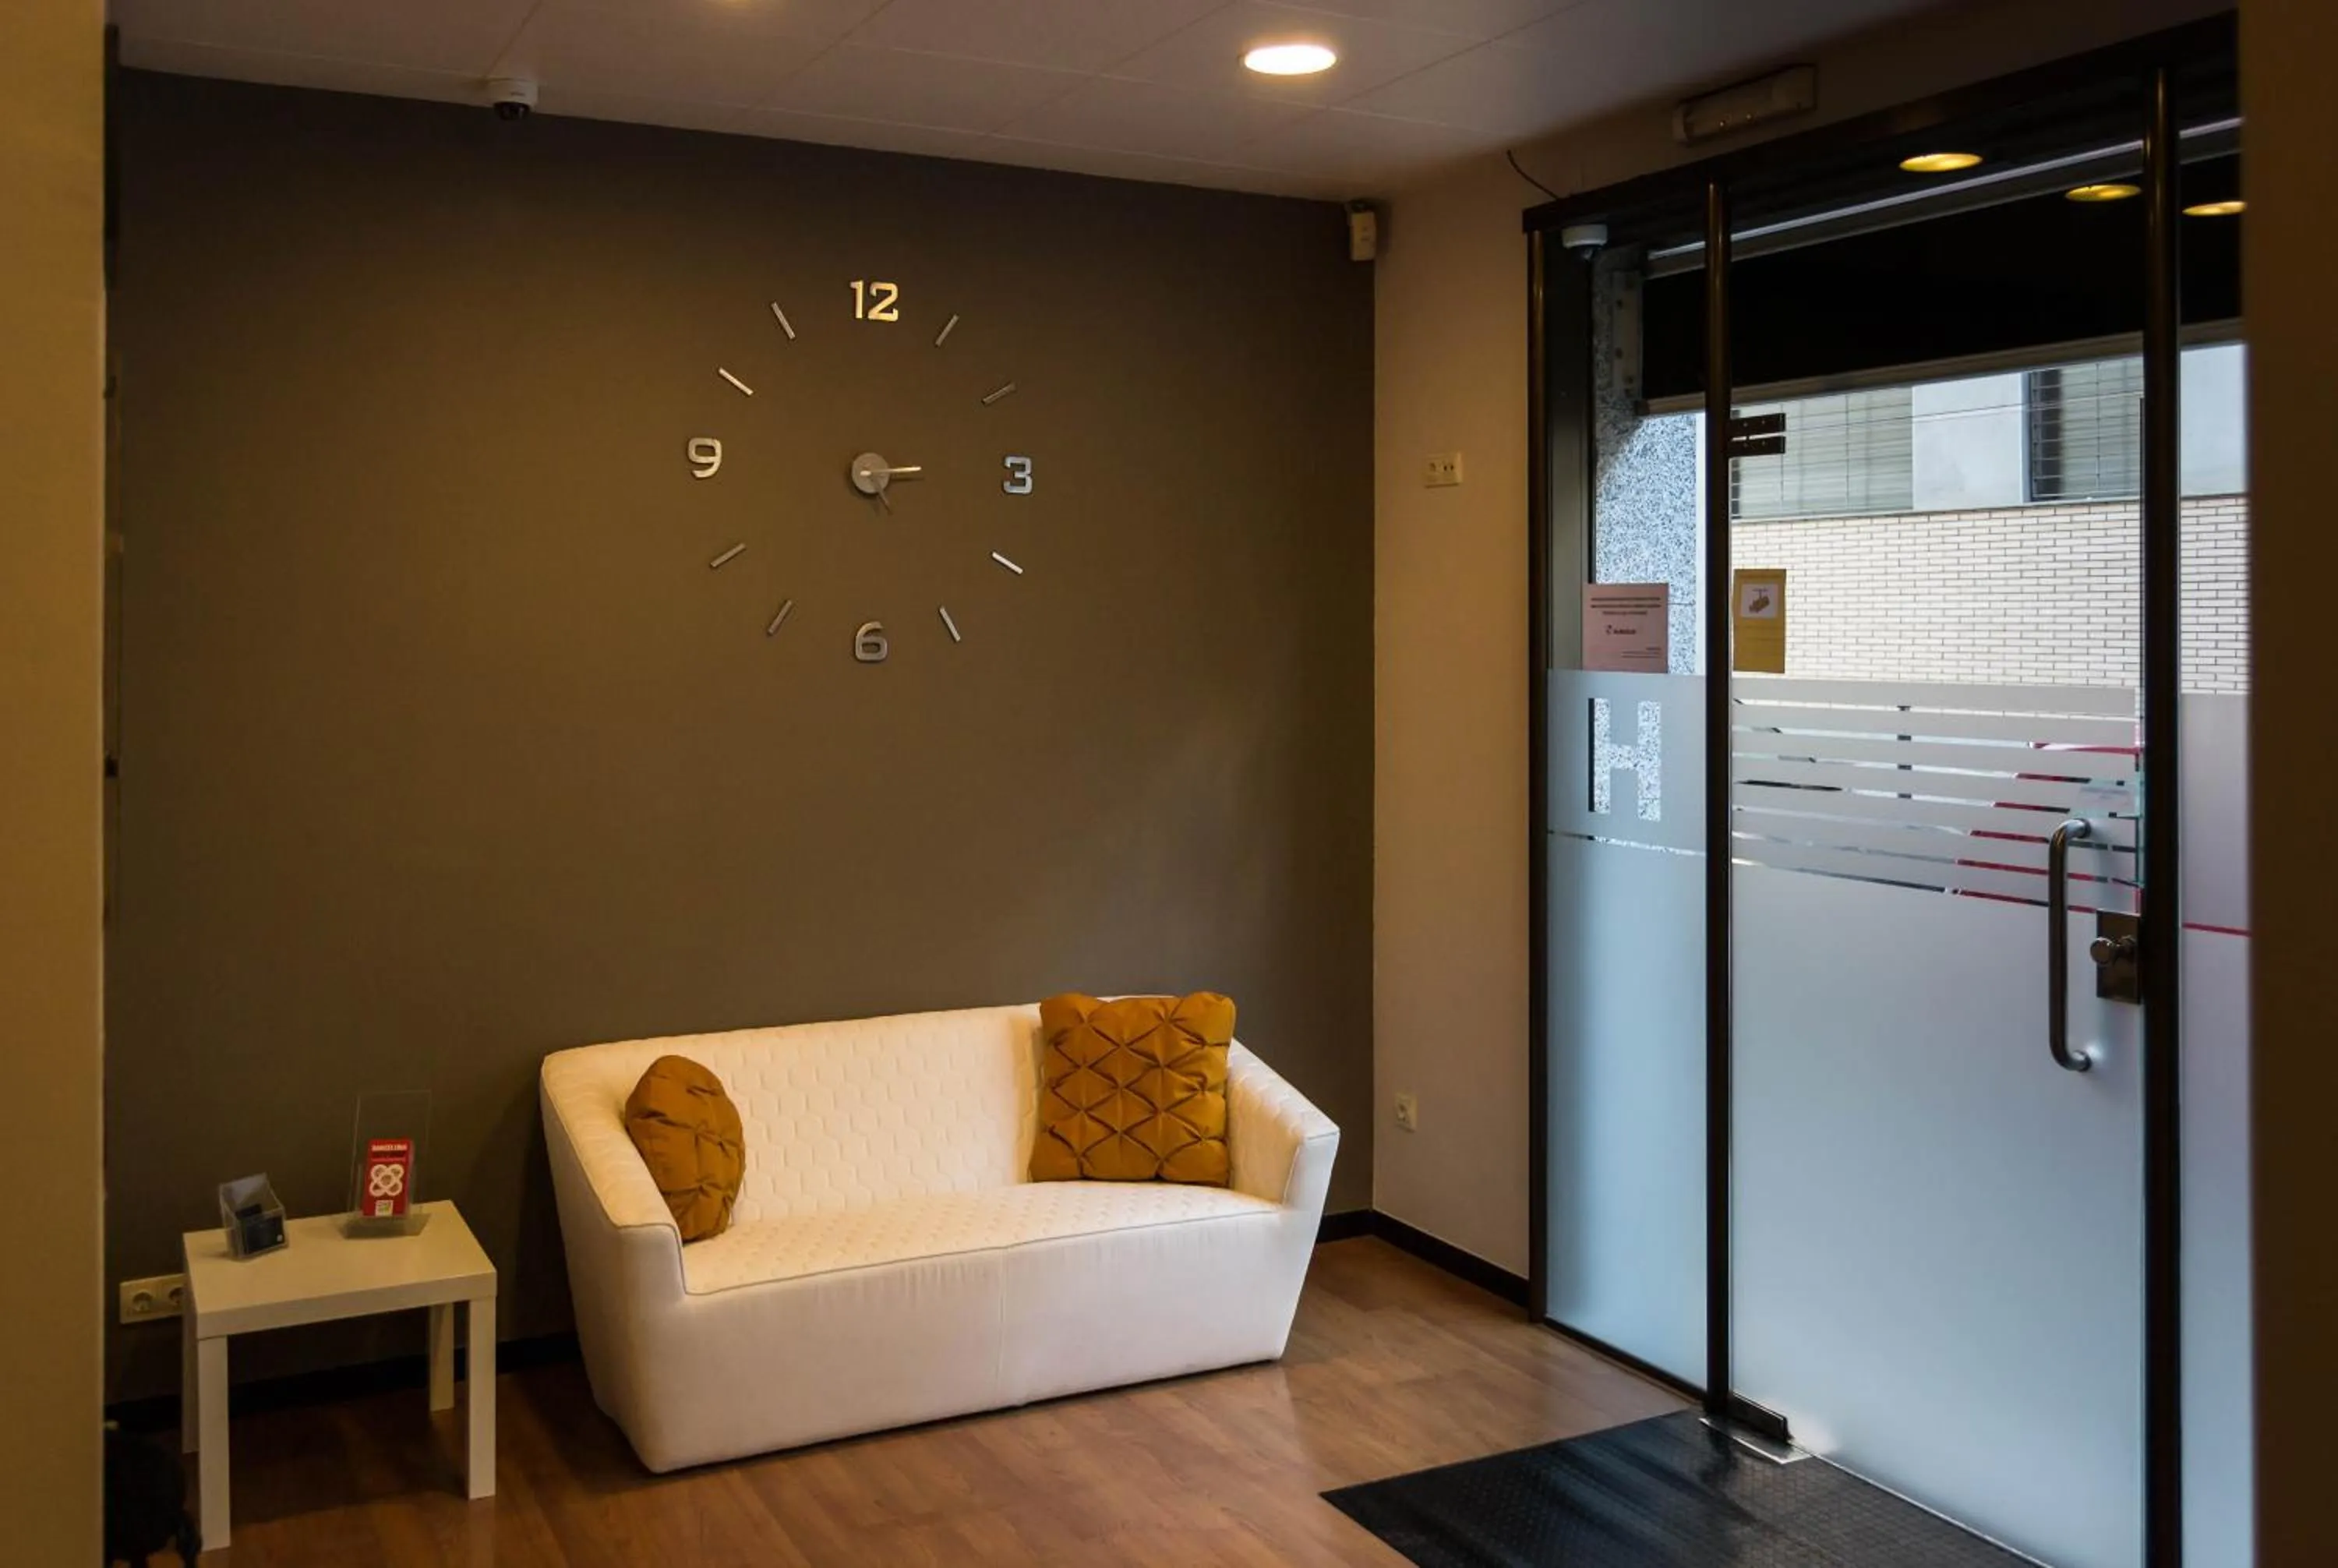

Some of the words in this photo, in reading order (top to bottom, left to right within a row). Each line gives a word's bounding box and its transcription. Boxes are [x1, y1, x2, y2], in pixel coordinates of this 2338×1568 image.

[850, 280, 899, 322] 12
[687, 439, 722, 479] 9
[1003, 456, 1033, 495] 3
[855, 621, 888, 662] 6
[1588, 697, 1662, 822] H
